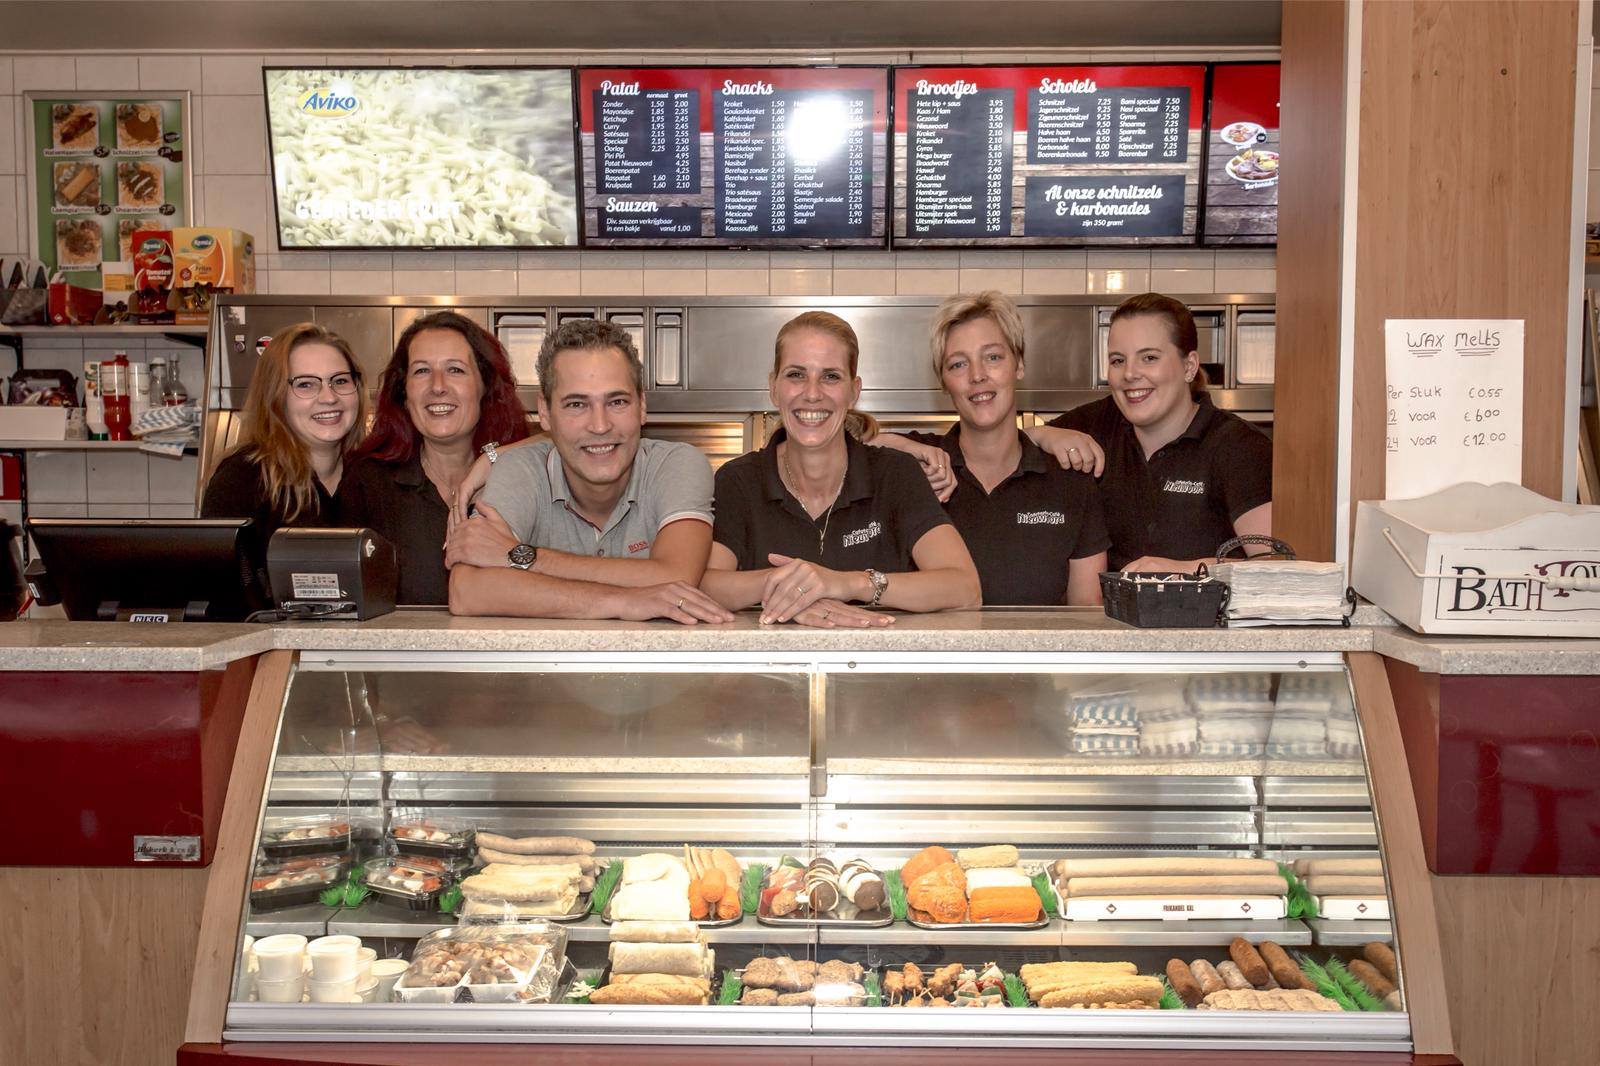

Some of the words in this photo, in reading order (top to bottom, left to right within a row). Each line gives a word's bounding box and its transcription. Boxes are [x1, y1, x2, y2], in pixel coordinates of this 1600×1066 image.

[601, 80, 640, 95] Patat
[722, 80, 774, 95] Snacks
[916, 80, 978, 99] Broodjes
[1039, 78, 1097, 94] Schotels
[303, 92, 356, 110] Aviko
[1045, 185, 1062, 202] Al
[1064, 188, 1095, 199] onze
[1097, 185, 1163, 199] schnitzels
[606, 197, 658, 212] Sauzen
[1056, 201, 1068, 216] &
[1070, 202, 1150, 216] karbonades
[1407, 332, 1444, 347] WAX
[1388, 385, 1403, 399] Per
[1387, 437, 1398, 448] 24
[628, 541, 647, 551] BOSS
[1448, 566, 1543, 611] BATH
